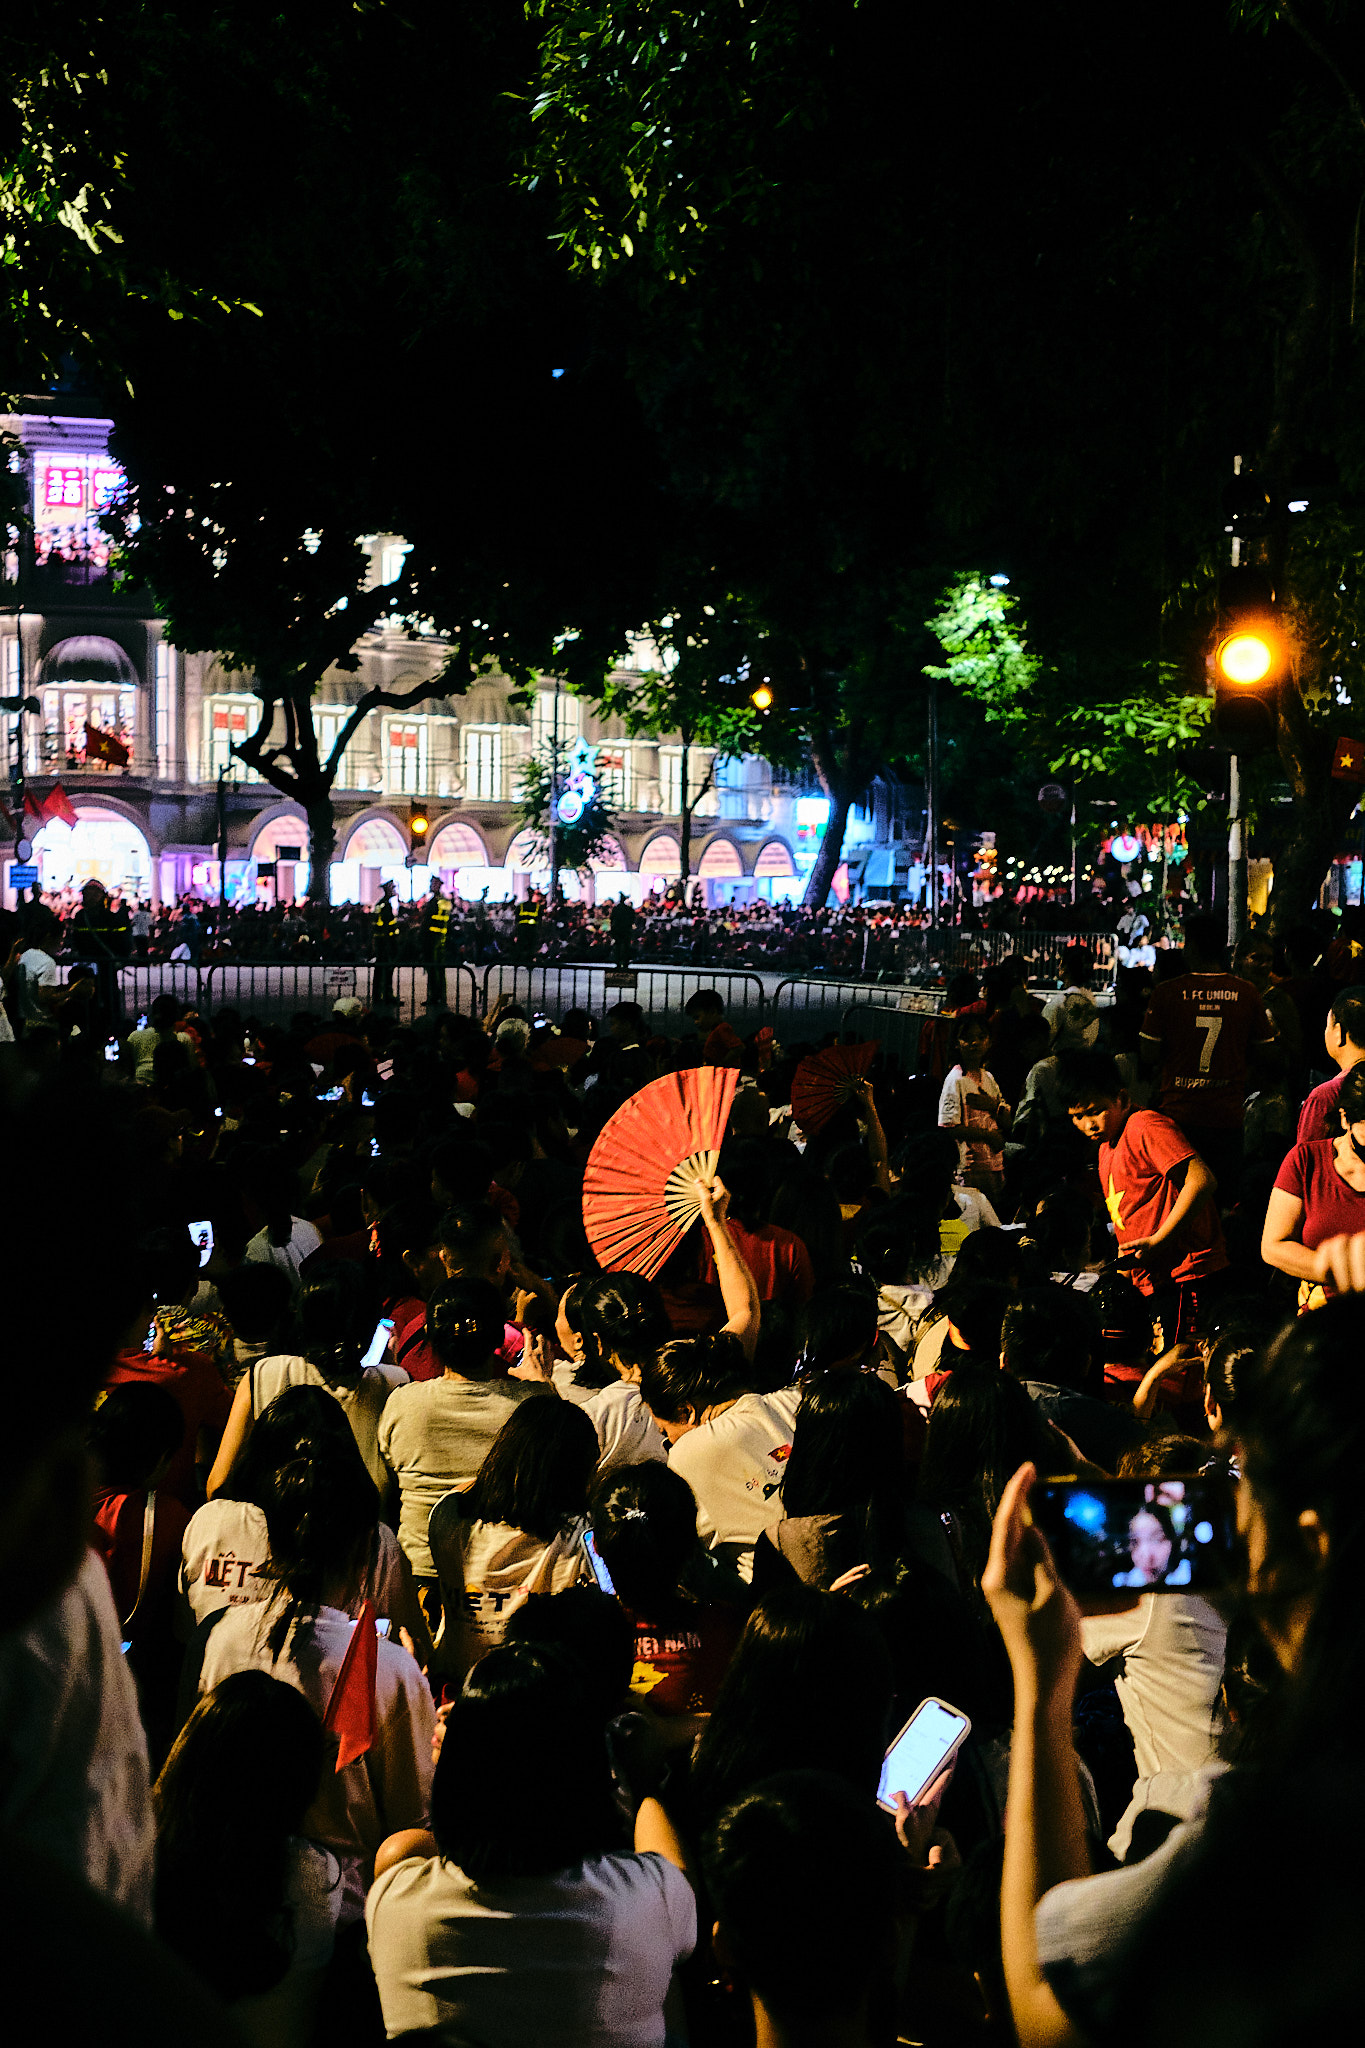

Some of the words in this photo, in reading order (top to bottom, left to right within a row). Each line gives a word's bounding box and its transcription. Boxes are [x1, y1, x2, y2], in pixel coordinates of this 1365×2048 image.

[1191, 989, 1204, 1000] FC
[1206, 989, 1239, 1002] UNION
[1195, 1015, 1223, 1073] 7
